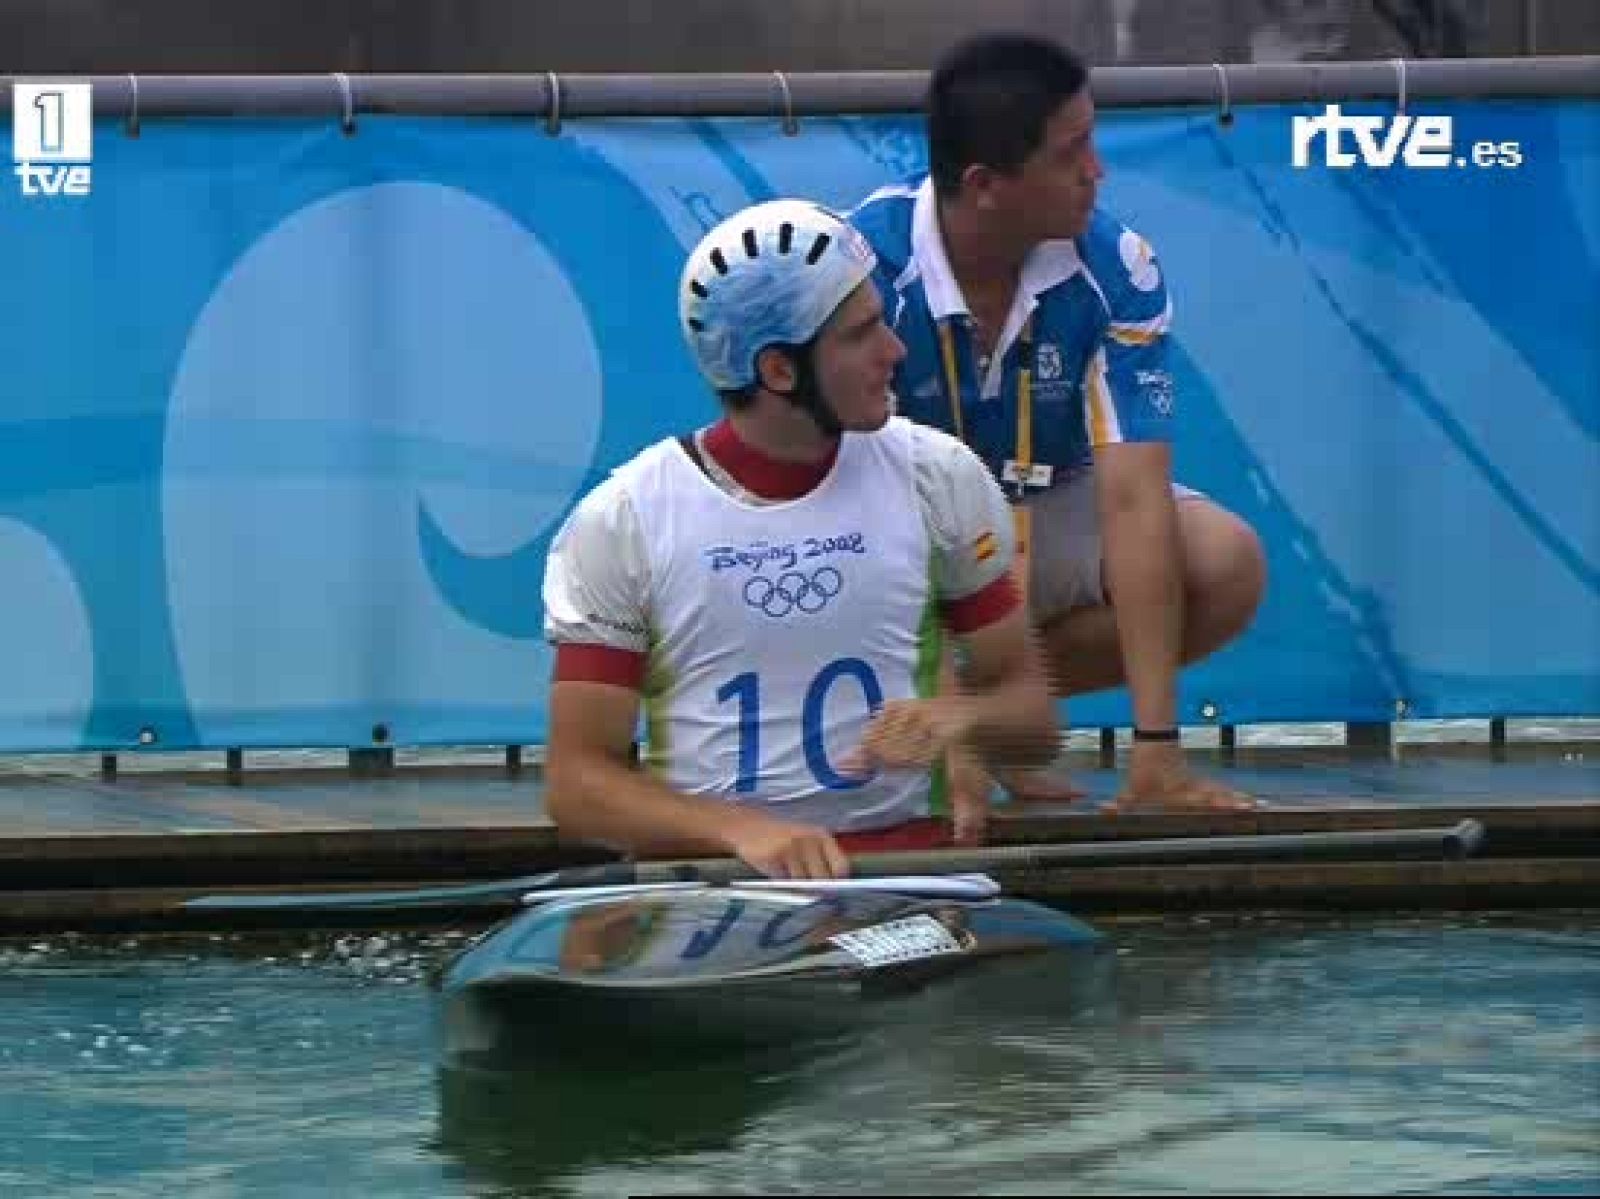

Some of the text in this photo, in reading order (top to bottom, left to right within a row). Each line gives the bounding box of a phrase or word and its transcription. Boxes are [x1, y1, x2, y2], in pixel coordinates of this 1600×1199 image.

[705, 532, 865, 571] Beijing 2008
[716, 657, 886, 792] 10
